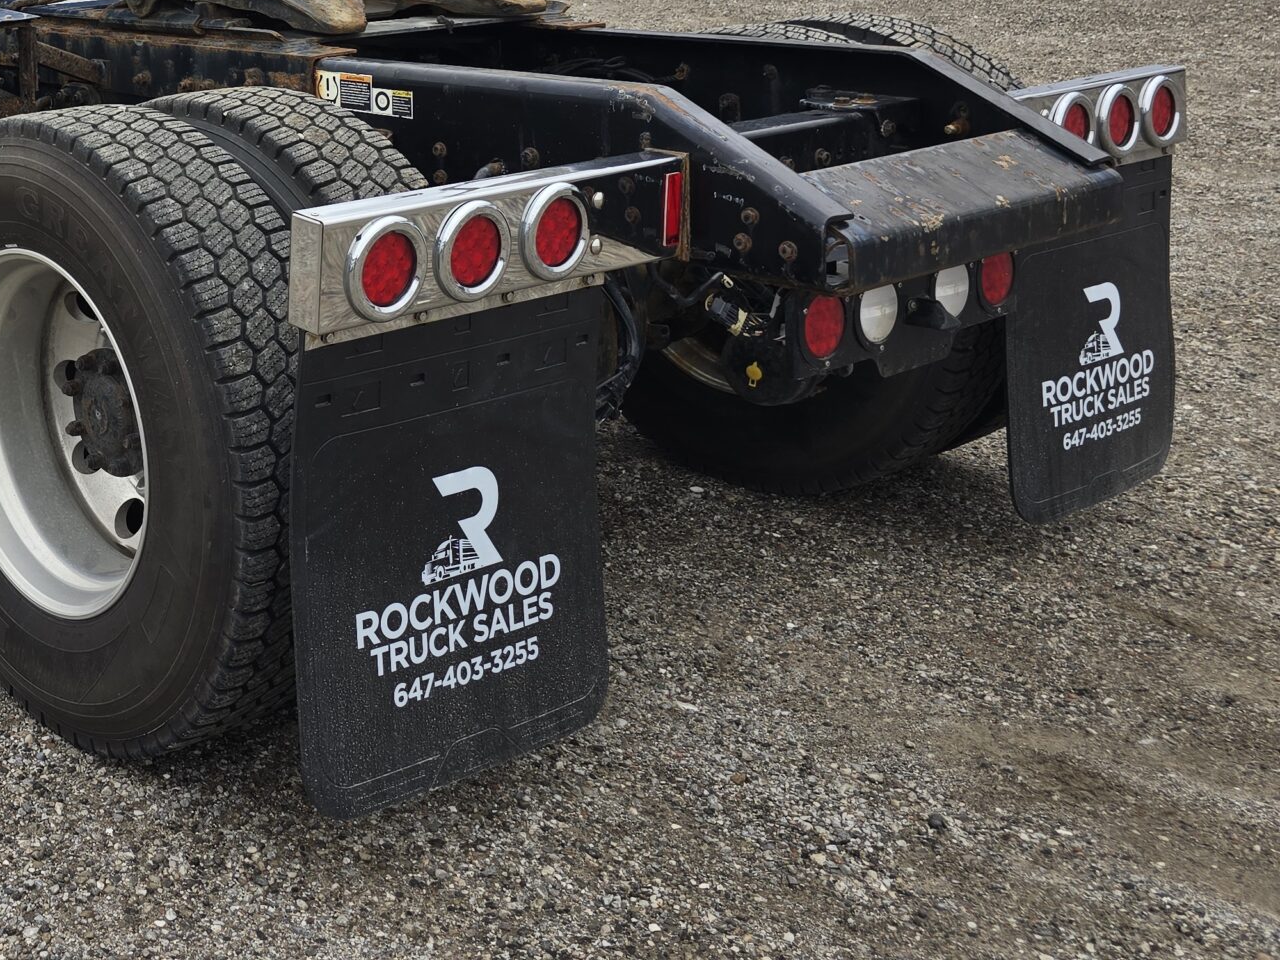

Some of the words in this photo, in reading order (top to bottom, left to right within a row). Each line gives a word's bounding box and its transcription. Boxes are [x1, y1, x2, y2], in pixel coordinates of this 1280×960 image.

[1041, 349, 1154, 408] ROCKWOOD
[1050, 392, 1106, 428] TRUCK
[1107, 377, 1150, 410] SALES
[1063, 408, 1142, 450] 647-403-3255
[355, 553, 561, 650] ROCKWOOD
[370, 620, 468, 677] TRUCK
[472, 591, 554, 643] SALES
[393, 635, 540, 708] 647-403-3255
